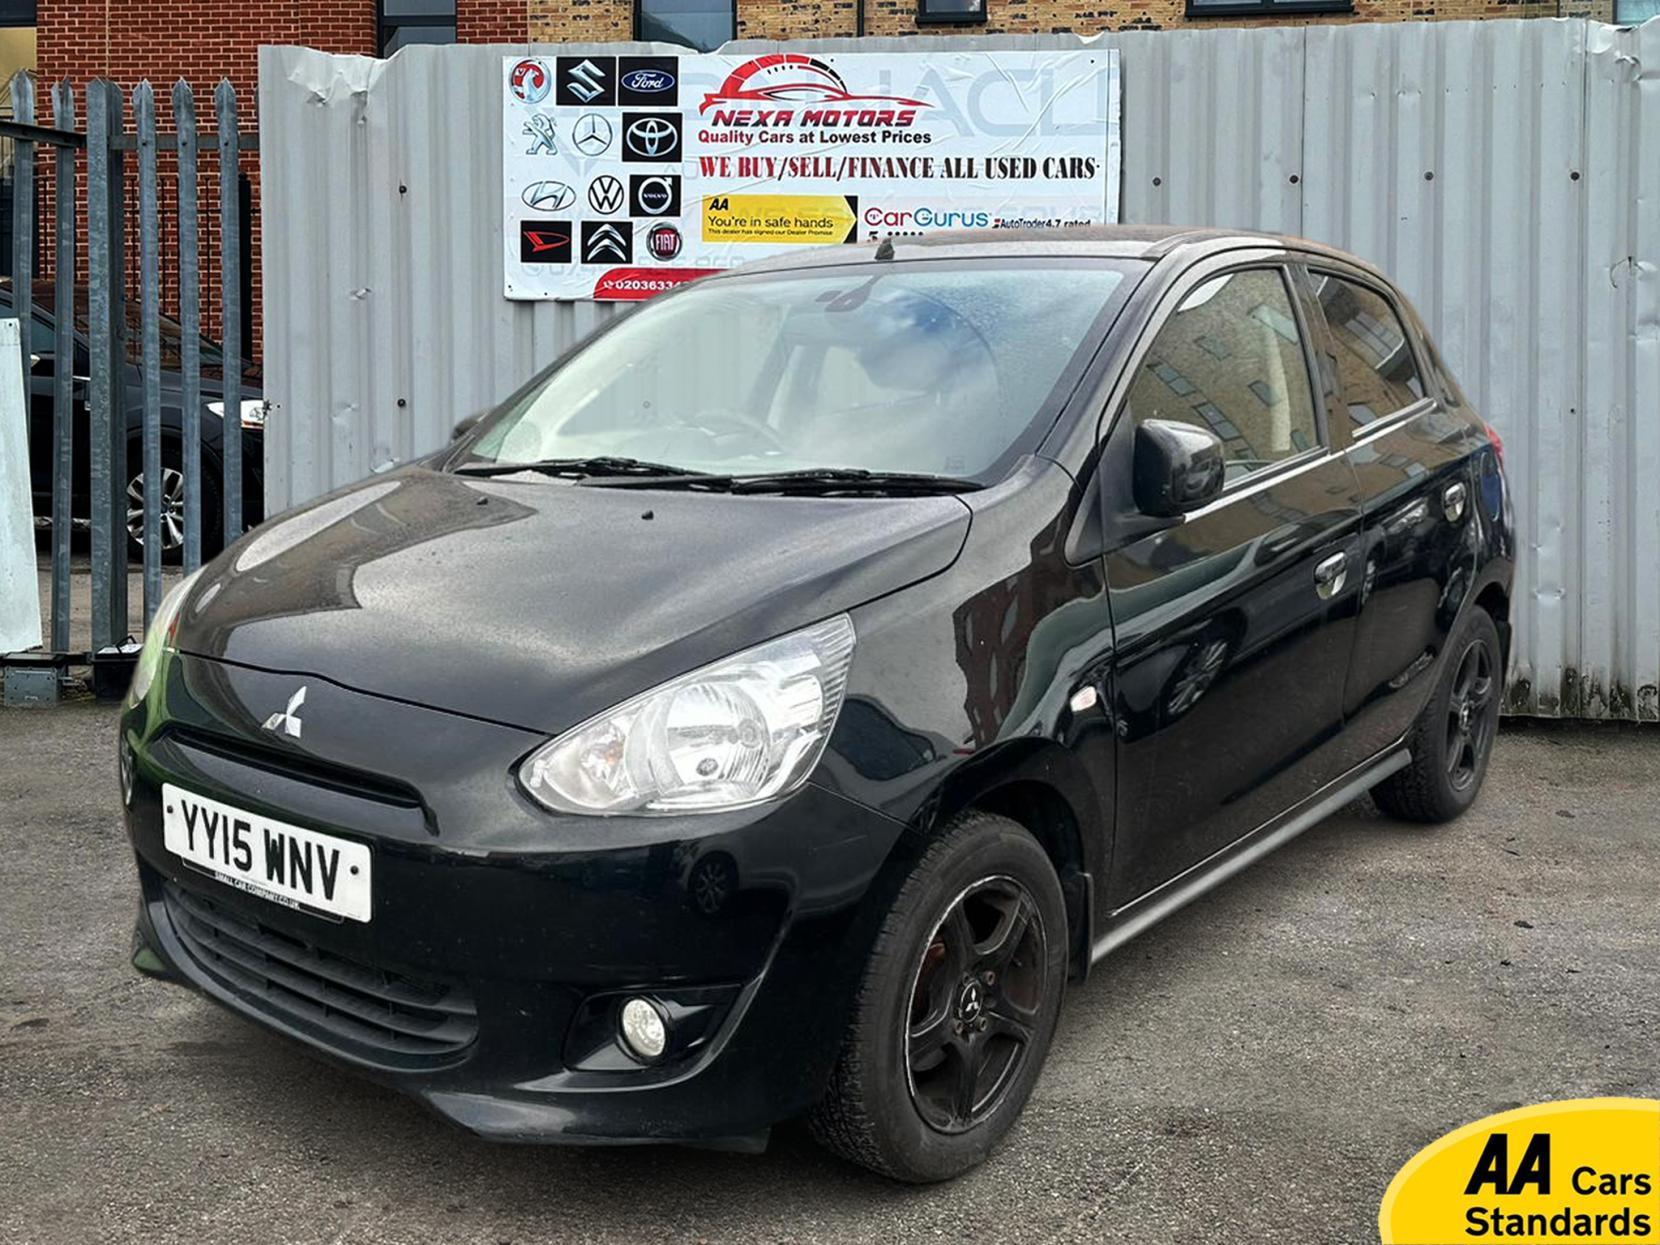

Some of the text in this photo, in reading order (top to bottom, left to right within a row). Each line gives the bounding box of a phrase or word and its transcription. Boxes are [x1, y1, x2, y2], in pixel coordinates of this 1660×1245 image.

[630, 74, 663, 89] Ford
[711, 110, 917, 127] NEXA MOTORS
[698, 130, 932, 146] Quality Cars at Lowest Prices
[699, 156, 731, 178] WE
[738, 156, 934, 181] BUY/SELL/FINANCE
[940, 157, 979, 178] ALL
[985, 157, 1037, 179] USED
[709, 198, 729, 210] AA
[708, 216, 834, 228] You're in safe hands
[864, 207, 988, 227] CarGurus
[655, 234, 676, 250] FIAT
[181, 799, 340, 901] YY15 WNV
